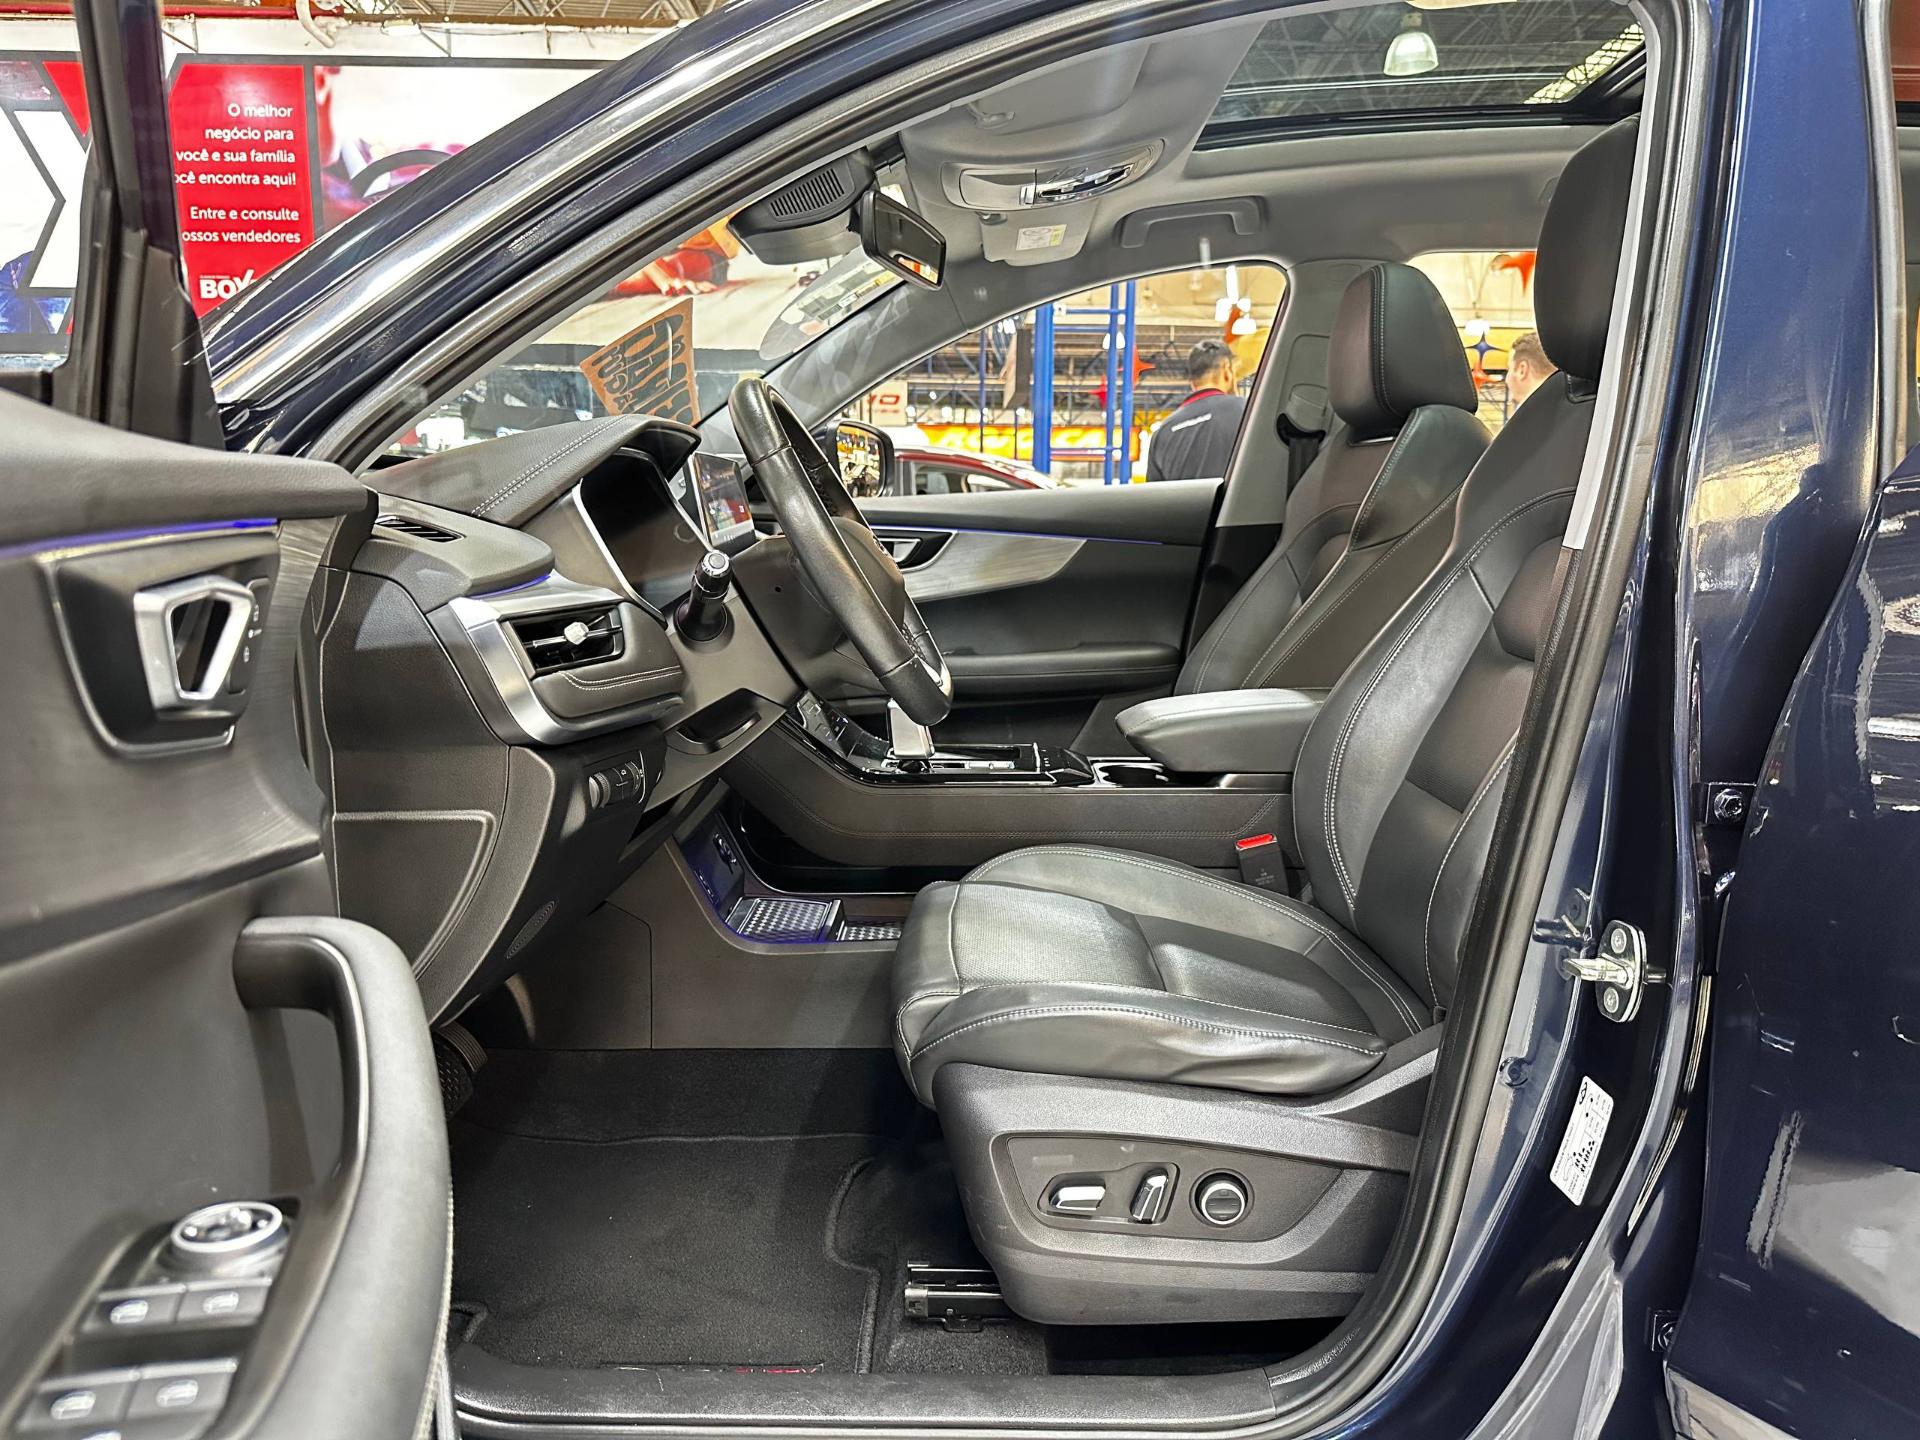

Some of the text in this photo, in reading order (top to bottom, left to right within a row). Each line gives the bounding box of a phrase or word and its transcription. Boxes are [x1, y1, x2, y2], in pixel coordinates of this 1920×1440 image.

[227, 103, 293, 118] O melhor
[204, 127, 295, 143] negócio para
[175, 148, 296, 163] você e sua família
[198, 172, 260, 185] encontra
[262, 173, 297, 187] aqui!
[190, 206, 299, 221] Entre e consulte
[221, 231, 301, 244] vendedores
